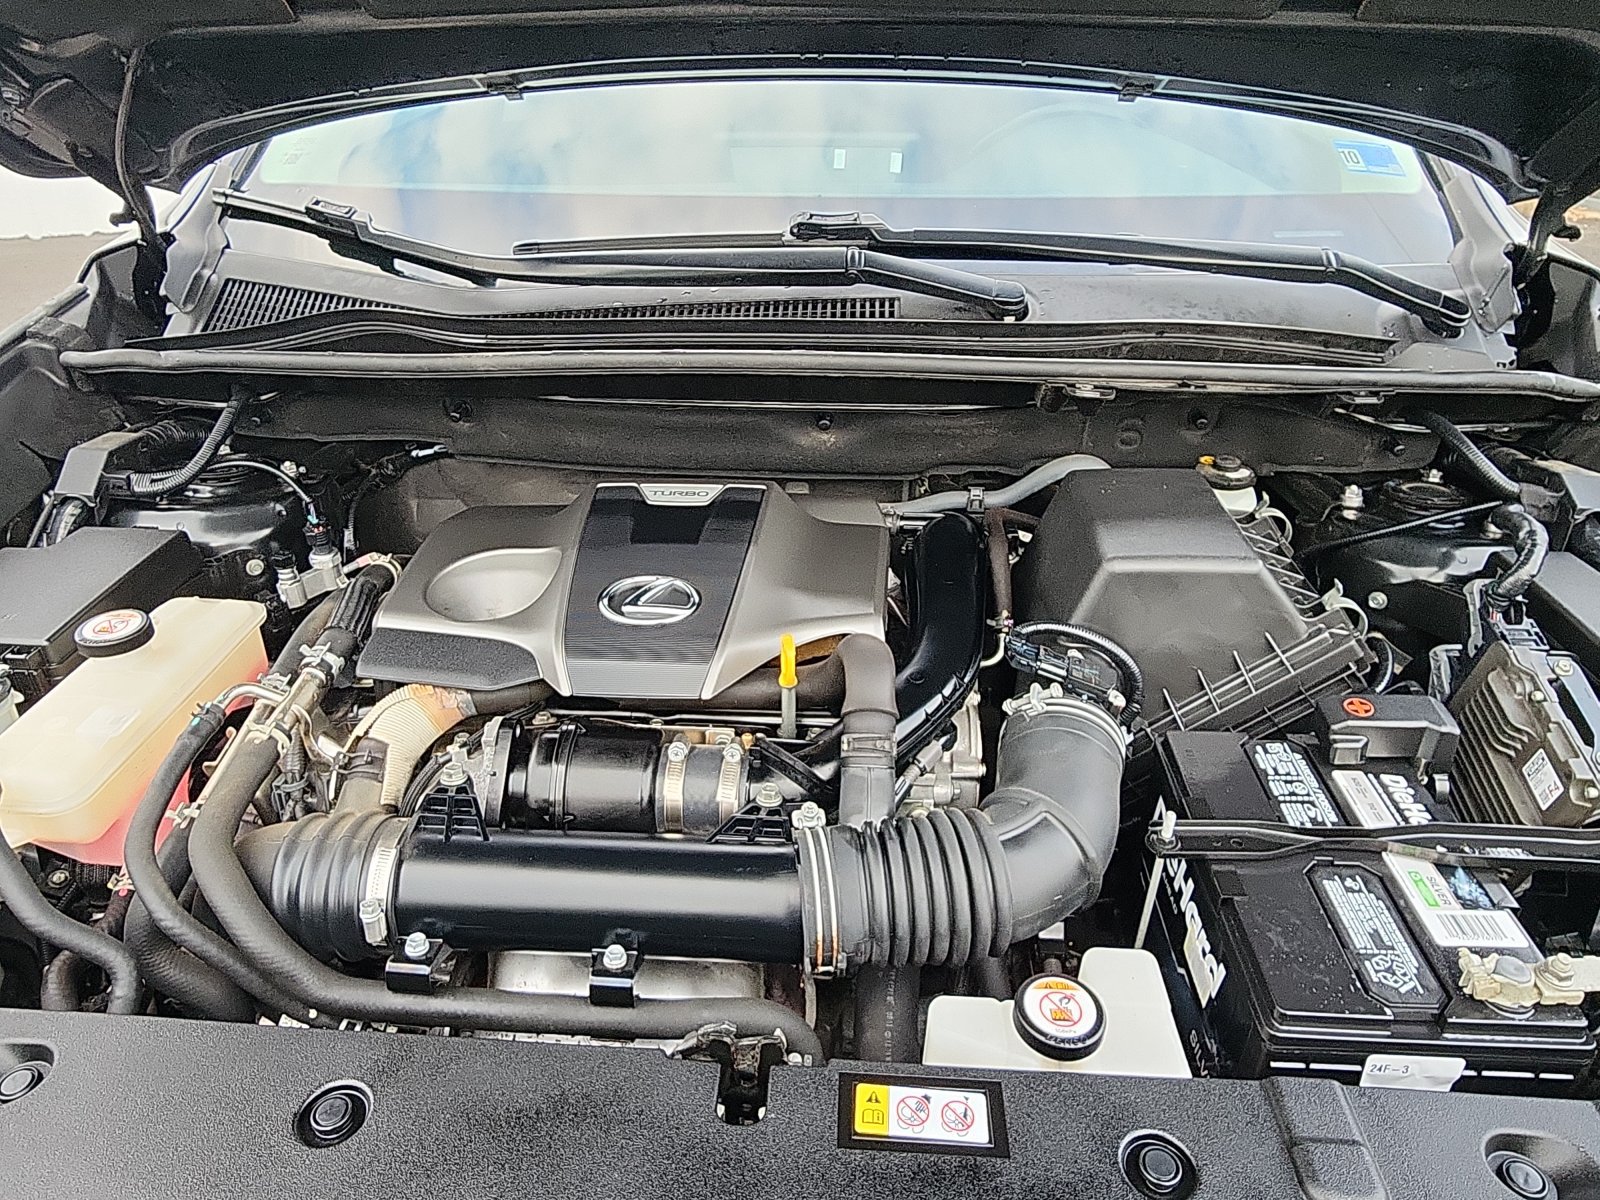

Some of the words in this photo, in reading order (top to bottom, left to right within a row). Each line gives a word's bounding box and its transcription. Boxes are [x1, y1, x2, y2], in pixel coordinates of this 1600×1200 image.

[1339, 150, 1361, 164] 10
[1426, 875, 1452, 906] SILVER
[1188, 1029, 1210, 1079] SILV
[1370, 1063, 1409, 1074] 24F-3
